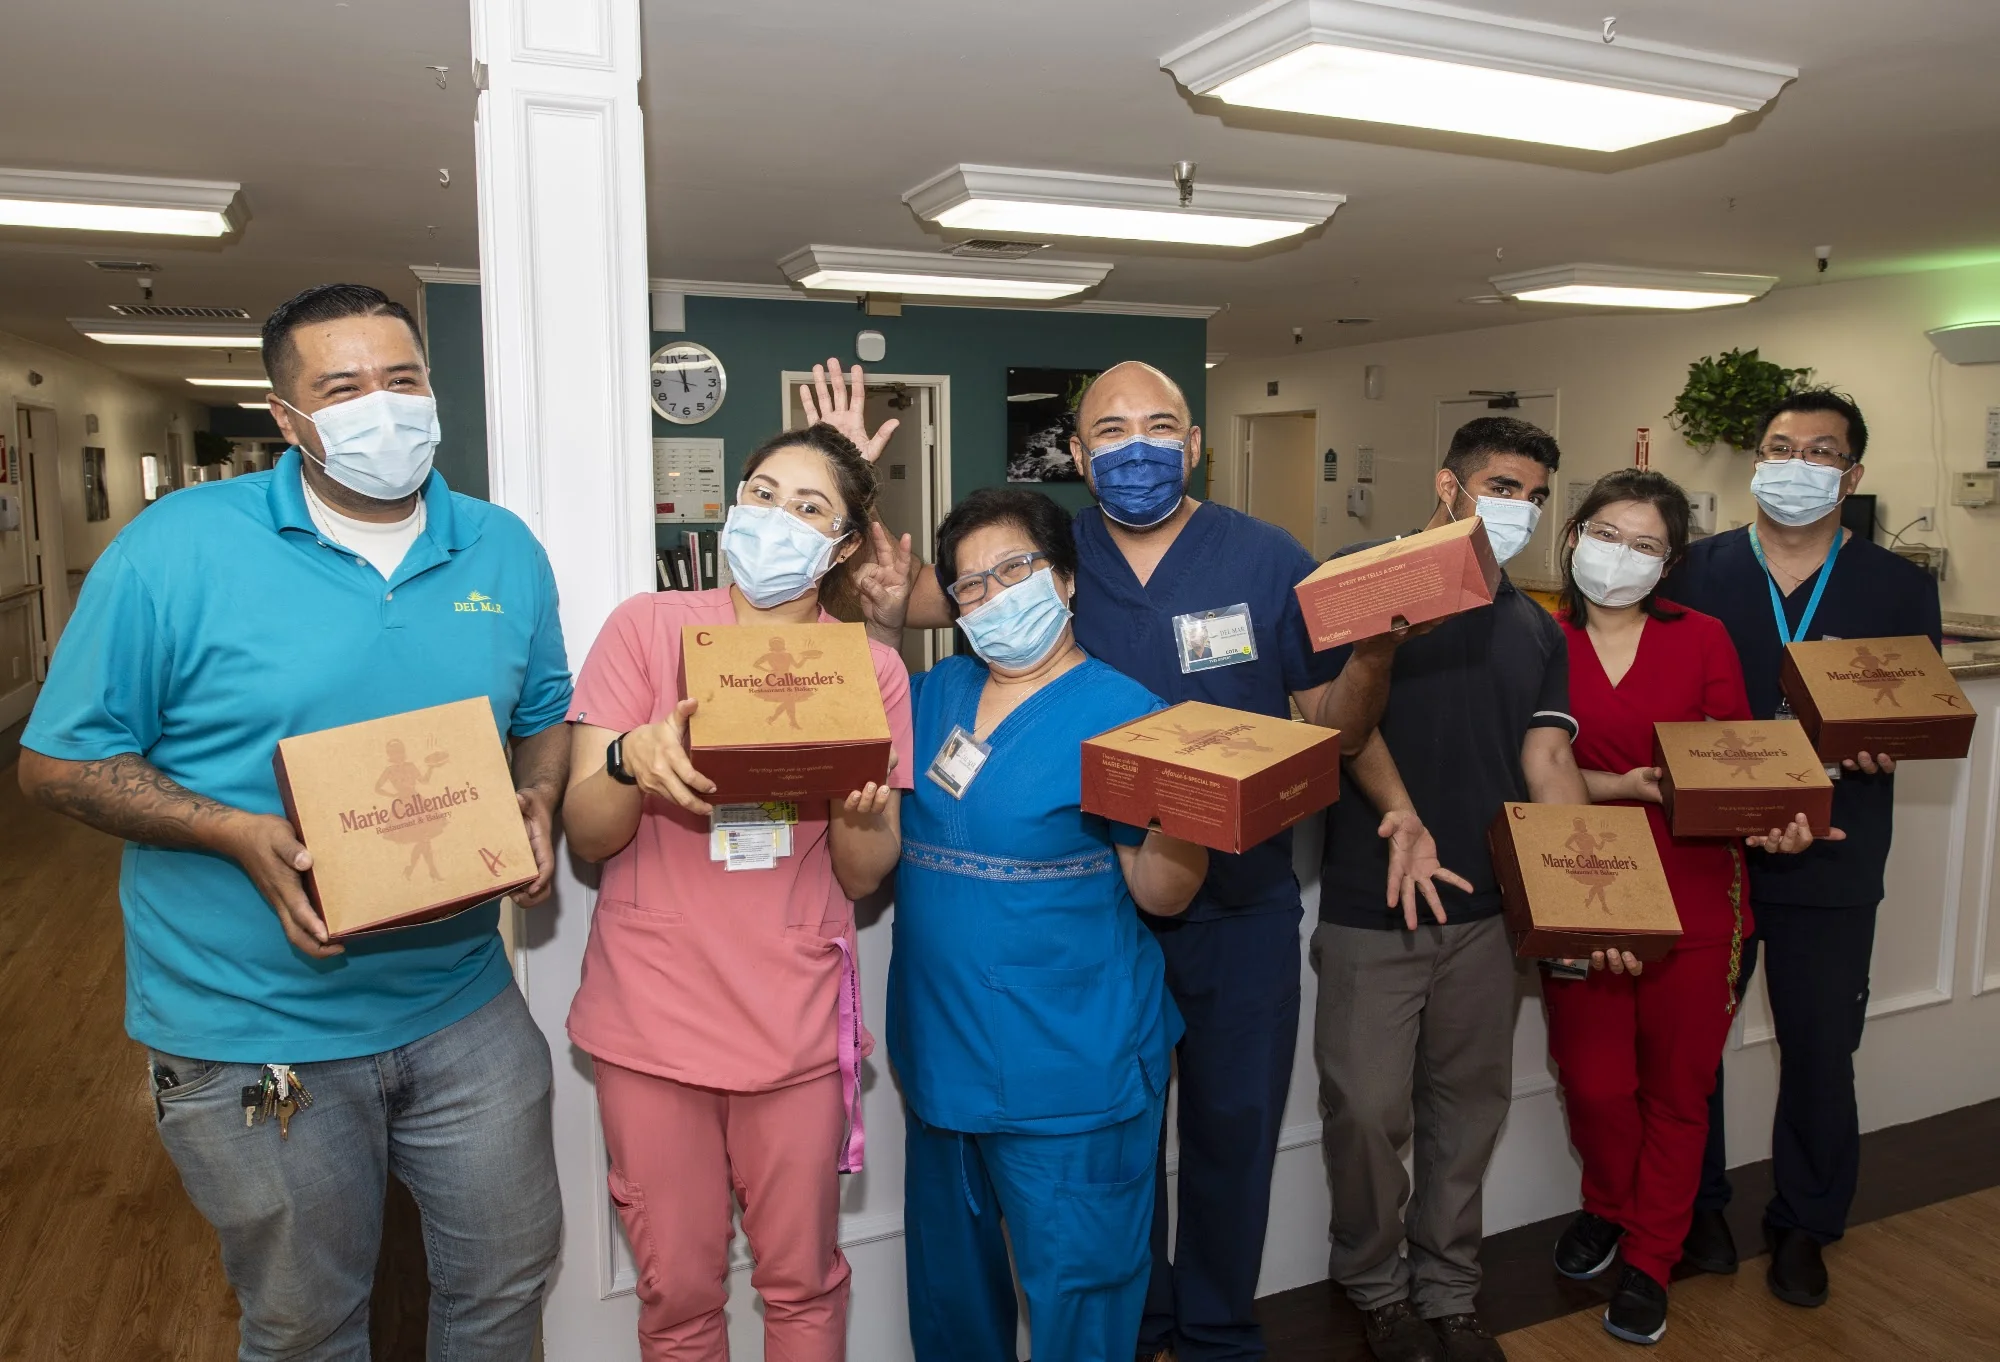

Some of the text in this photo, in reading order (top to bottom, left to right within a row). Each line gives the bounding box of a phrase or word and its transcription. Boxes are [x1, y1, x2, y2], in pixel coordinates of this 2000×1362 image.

[653, 379, 662, 388] 9
[708, 379, 717, 388] 3
[658, 393, 668, 401] 8
[706, 392, 714, 400] 4
[669, 403, 677, 412] 7
[683, 407, 691, 416] 6
[697, 403, 706, 411] 5
[1338, 578, 1356, 588] EVERY
[1367, 570, 1383, 580] TELLS
[1388, 564, 1406, 573] STORY
[454, 602, 478, 612] DEL
[696, 632, 713, 646] C
[1826, 667, 1926, 681] Marie Callender's
[720, 672, 844, 688] Marie Callender's
[1688, 748, 1788, 758] Marie Callender's
[339, 782, 479, 834] Marie Callender's
[1513, 806, 1526, 820] C
[376, 819, 416, 834] Restaurant
[426, 810, 452, 822] Bakery
[1541, 854, 1638, 870] Marie Callender's
